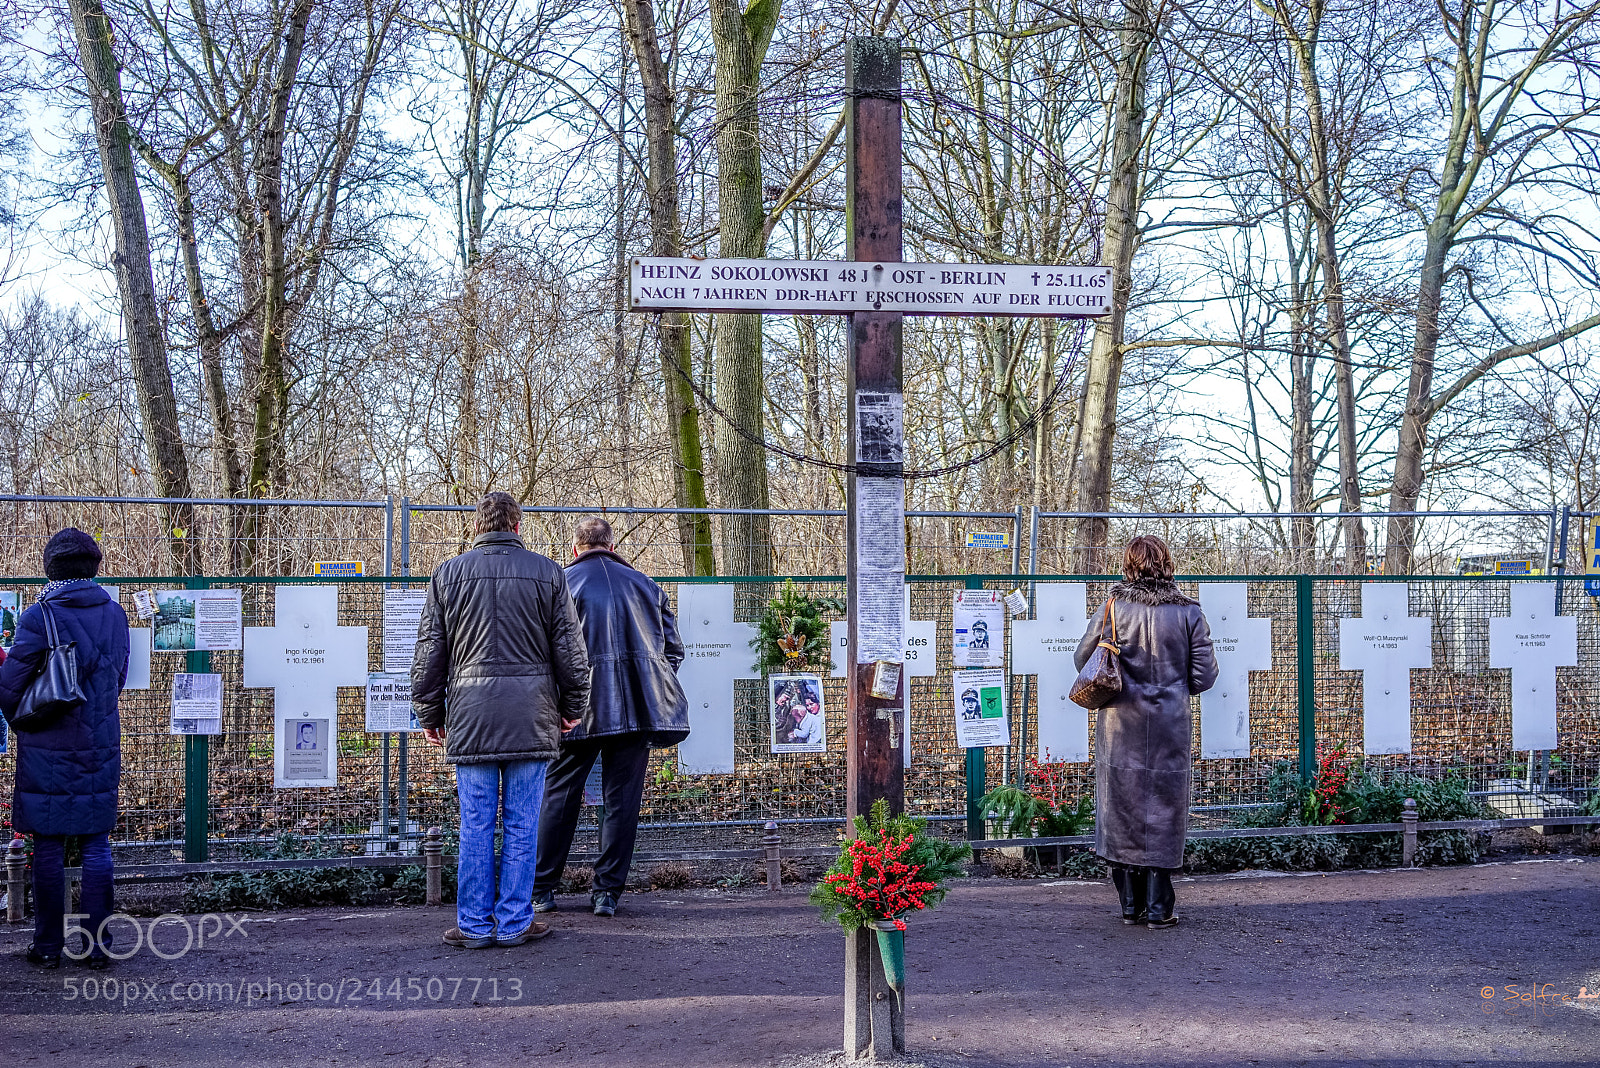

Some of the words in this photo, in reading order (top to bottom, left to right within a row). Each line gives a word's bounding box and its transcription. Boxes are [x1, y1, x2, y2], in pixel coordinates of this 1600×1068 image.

[640, 265, 702, 280] HEINZ
[711, 266, 829, 282] SOKOLOWSKI
[838, 269, 857, 283] 48
[861, 269, 869, 283] J
[940, 271, 1006, 286] BERLIN
[1046, 273, 1107, 288] 25.11.65
[640, 287, 686, 300] NACH
[692, 288, 700, 300] 7
[703, 288, 768, 301] JAHREN
[776, 289, 858, 302] DDR-HAFT
[865, 290, 964, 303] ERSCHOSSEN
[972, 293, 1002, 305] AUF
[1009, 293, 1041, 306] DER
[1048, 294, 1107, 307] FLUCHT
[907, 636, 928, 647] des
[285, 648, 300, 657] Ingo
[302, 647, 326, 657] Krüger
[370, 683, 382, 692] Amt
[383, 683, 393, 692] will
[370, 693, 380, 701] vor
[381, 692, 393, 701] dem
